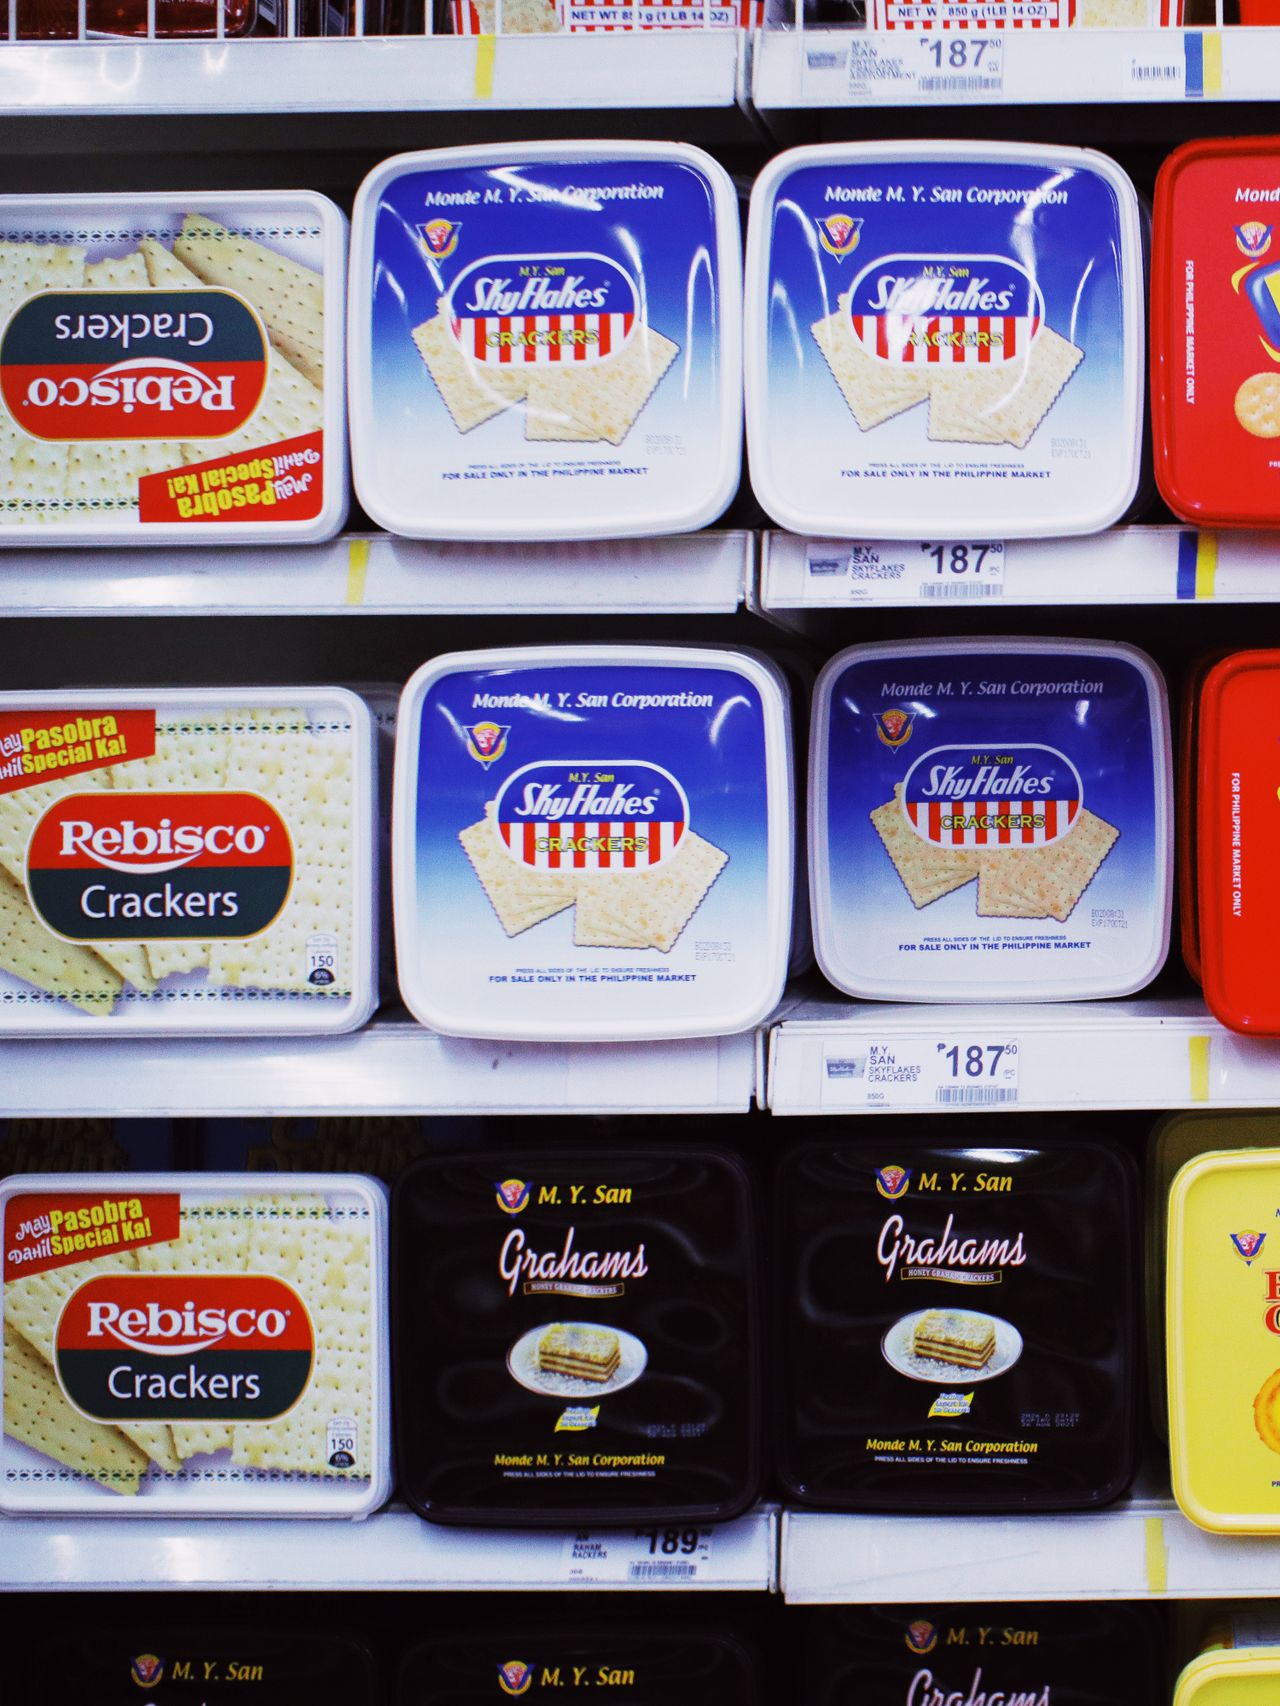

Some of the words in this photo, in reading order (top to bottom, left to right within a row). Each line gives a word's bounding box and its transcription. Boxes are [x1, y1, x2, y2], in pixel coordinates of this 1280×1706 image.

[898, 8, 919, 17] NET
[825, 186, 881, 202] Monde
[886, 187, 905, 202] M.
[911, 187, 925, 202] Y.
[930, 187, 962, 202] San
[55, 313, 213, 348] Crackers
[486, 329, 600, 348] CRACKERS
[27, 358, 235, 413] Rebisco
[167, 473, 200, 497] Ka!
[202, 458, 275, 489] Special
[178, 481, 277, 519] Pasobra
[881, 682, 932, 698] Monde
[937, 682, 954, 697] M.
[960, 682, 973, 697] Y.
[977, 681, 1006, 696] San
[1010, 680, 1103, 698] Corporation
[21, 715, 118, 749] Pasobra
[22, 745, 93, 775] Special
[96, 735, 127, 757] Ka!
[921, 764, 1054, 801] SkyFlakes
[514, 783, 658, 821] SkyFlakes
[941, 815, 1046, 830] CRACKERS
[59, 819, 266, 873] Rebisco
[535, 836, 648, 853] CRACKERS
[81, 883, 238, 919] Crackers
[898, 943, 916, 951] FOR
[919, 943, 941, 951] SALE
[943, 942, 967, 951] ONLY
[970, 942, 980, 951] IN
[981, 942, 1000, 950] THE
[1002, 942, 1051, 950] PHILIPPINE
[1054, 941, 1091, 949] MARKET
[310, 955, 334, 967] 150
[869, 1066, 921, 1074] SKYFLAKES
[870, 1055, 895, 1064] SAN
[868, 1074, 917, 1082] CRACKERS
[539, 1186, 562, 1204] M.
[570, 1186, 587, 1204] Y.
[593, 1185, 632, 1204] San
[919, 1173, 942, 1192] M.
[951, 1173, 967, 1192] Y.
[974, 1173, 1013, 1192] San
[50, 1199, 143, 1234] Pasobra
[50, 1226, 119, 1256] Special
[122, 1218, 152, 1240] Ka!
[877, 1214, 1027, 1284] Grahams
[500, 1226, 649, 1297] Grahams
[88, 1301, 288, 1355] Rebisco
[108, 1366, 260, 1399] Crackers
[331, 1438, 354, 1450] 150
[866, 1438, 905, 1451] Monde
[909, 1439, 923, 1452] M.
[927, 1439, 937, 1452] Y.
[940, 1439, 963, 1452] San
[965, 1439, 1038, 1454] Corporation
[541, 1668, 564, 1686] M.
[572, 1668, 590, 1686] Y.
[596, 1667, 634, 1686] San
